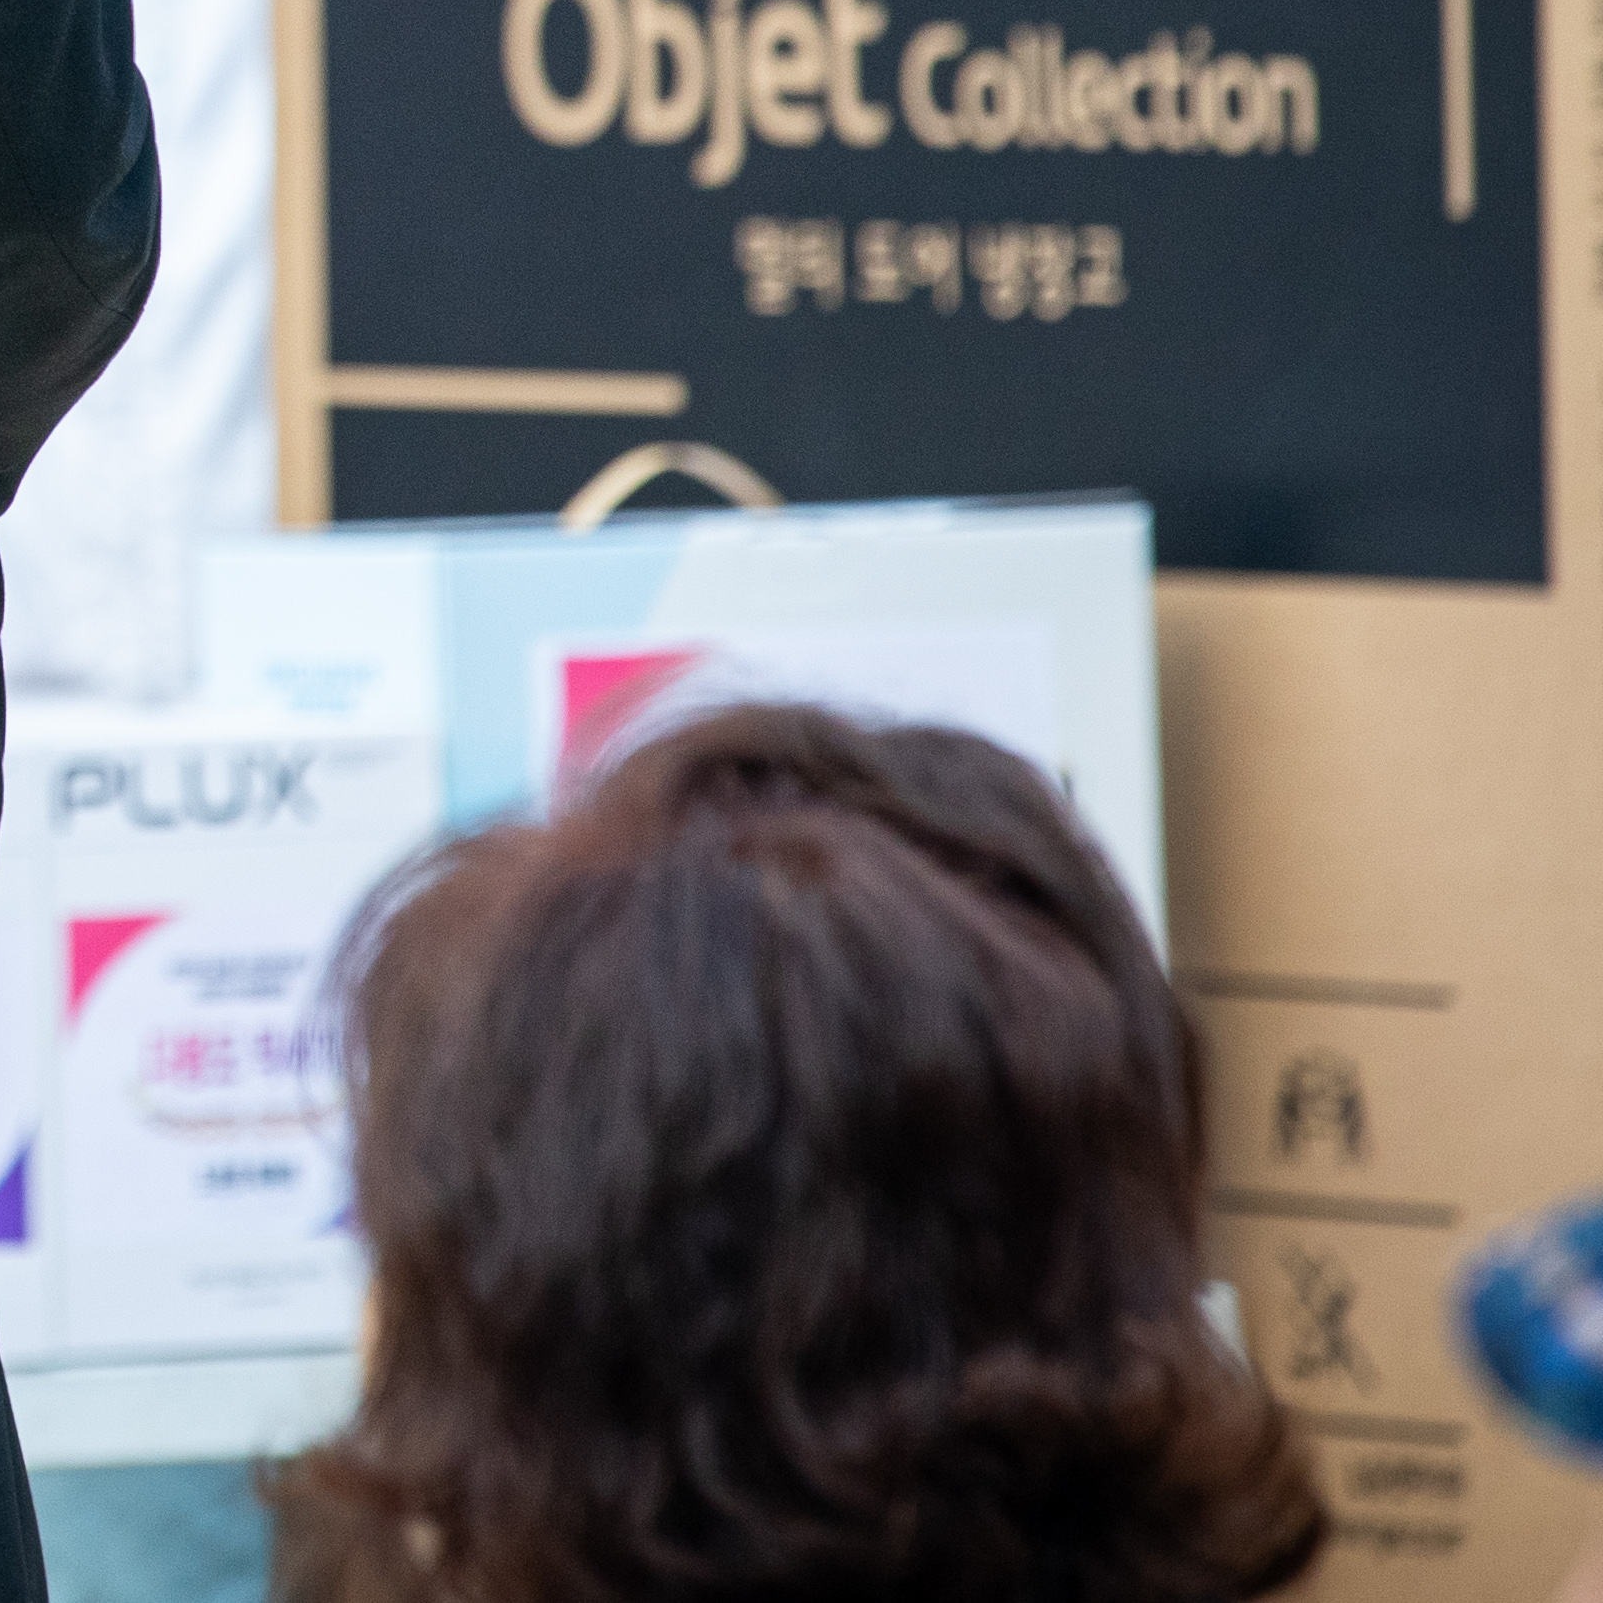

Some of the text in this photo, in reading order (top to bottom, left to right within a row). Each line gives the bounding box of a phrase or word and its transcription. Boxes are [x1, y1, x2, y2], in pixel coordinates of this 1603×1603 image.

[898, 20, 1320, 156] Collection
[854, 220, 962, 316] 도어
[969, 224, 1127, 322] 냉장고
[48, 748, 320, 834] PLUX
